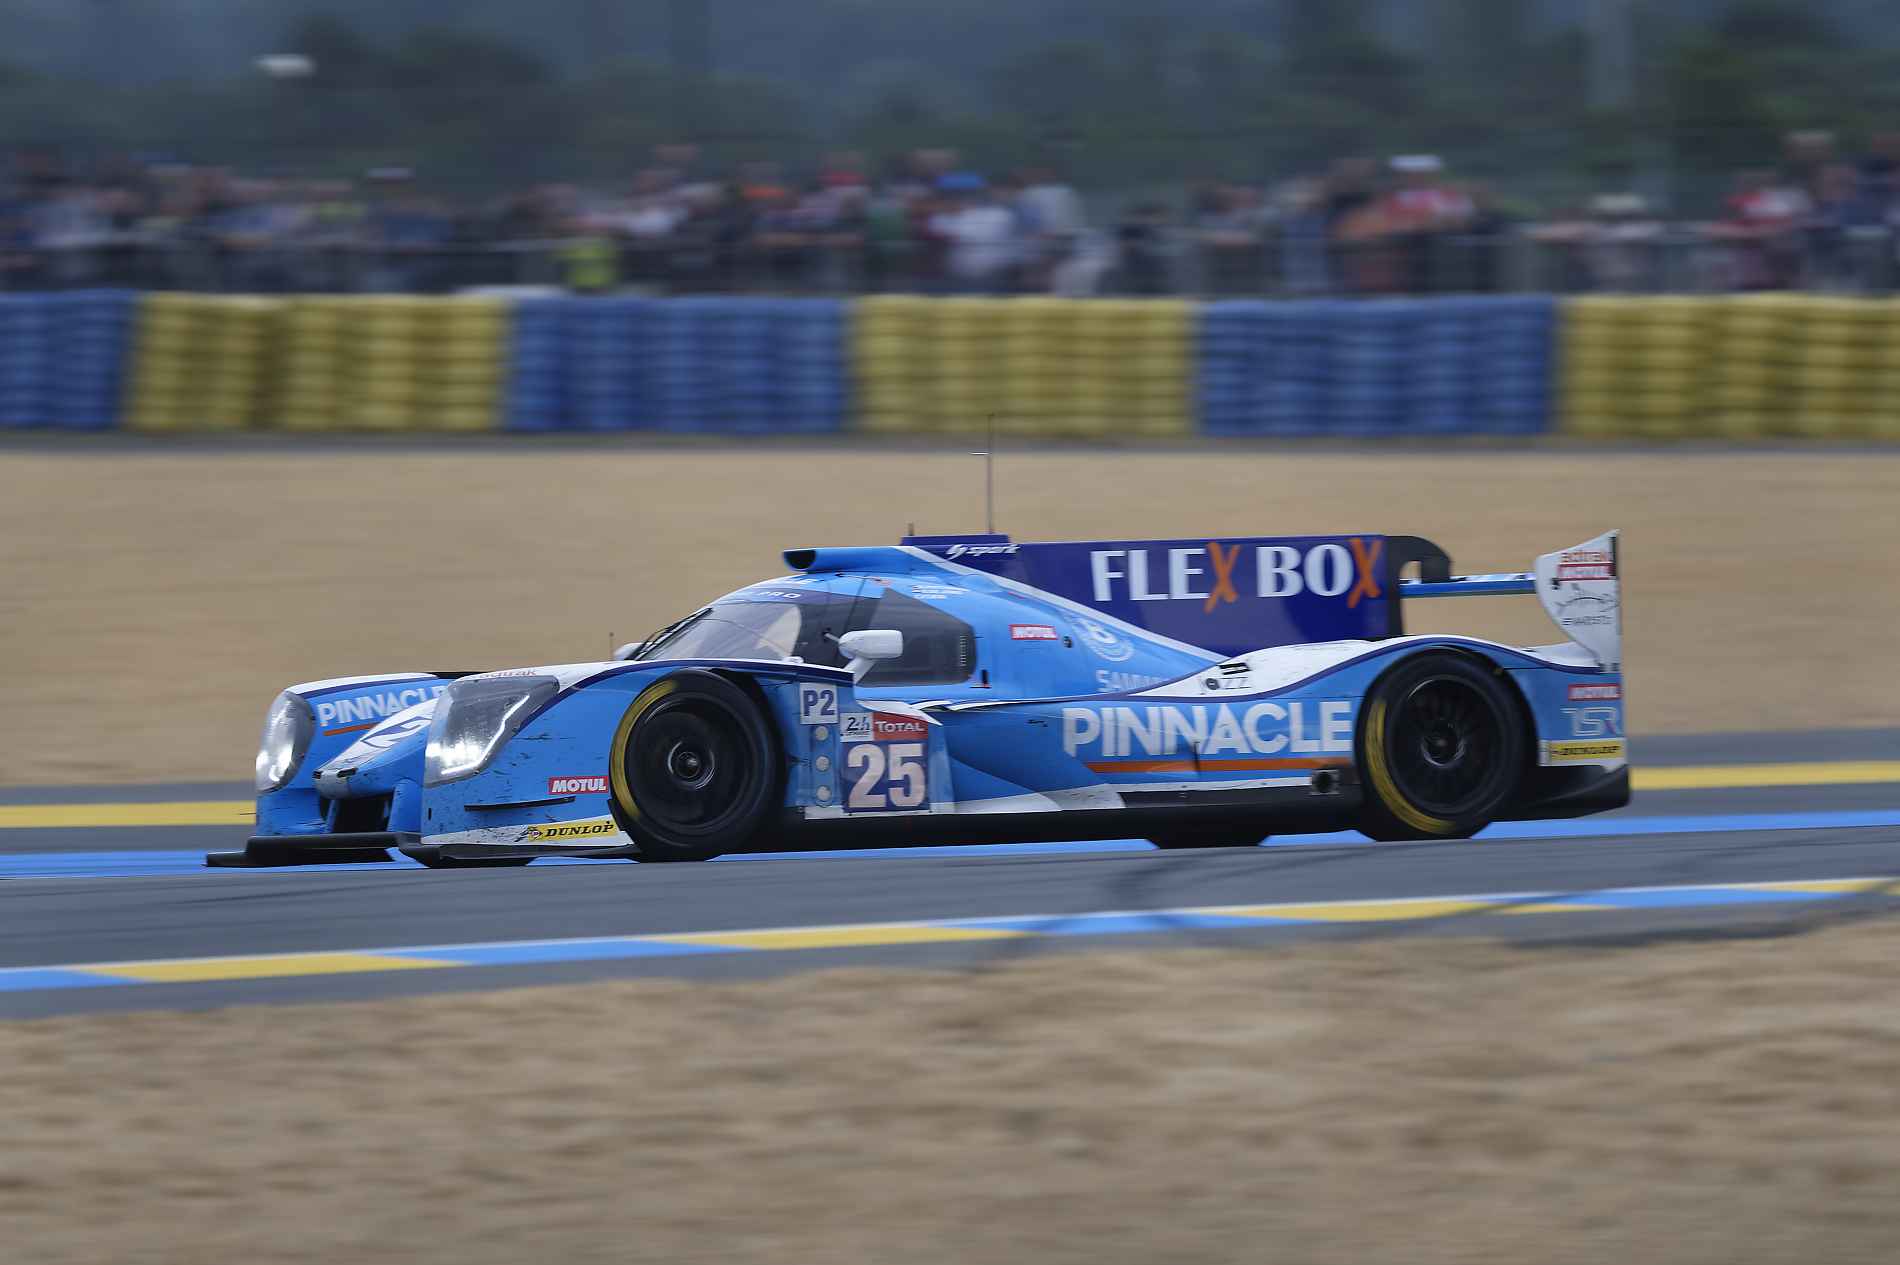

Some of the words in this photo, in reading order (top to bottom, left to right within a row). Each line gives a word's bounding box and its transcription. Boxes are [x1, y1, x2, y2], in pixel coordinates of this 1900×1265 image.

[1090, 542, 1240, 614] FLEX
[1256, 538, 1382, 608] BOX
[803, 690, 836, 716] P2
[1062, 701, 1353, 757] PINNACLE
[551, 778, 607, 793] MOTUL
[847, 743, 926, 808] 25
[546, 824, 614, 837] DUNLOP
